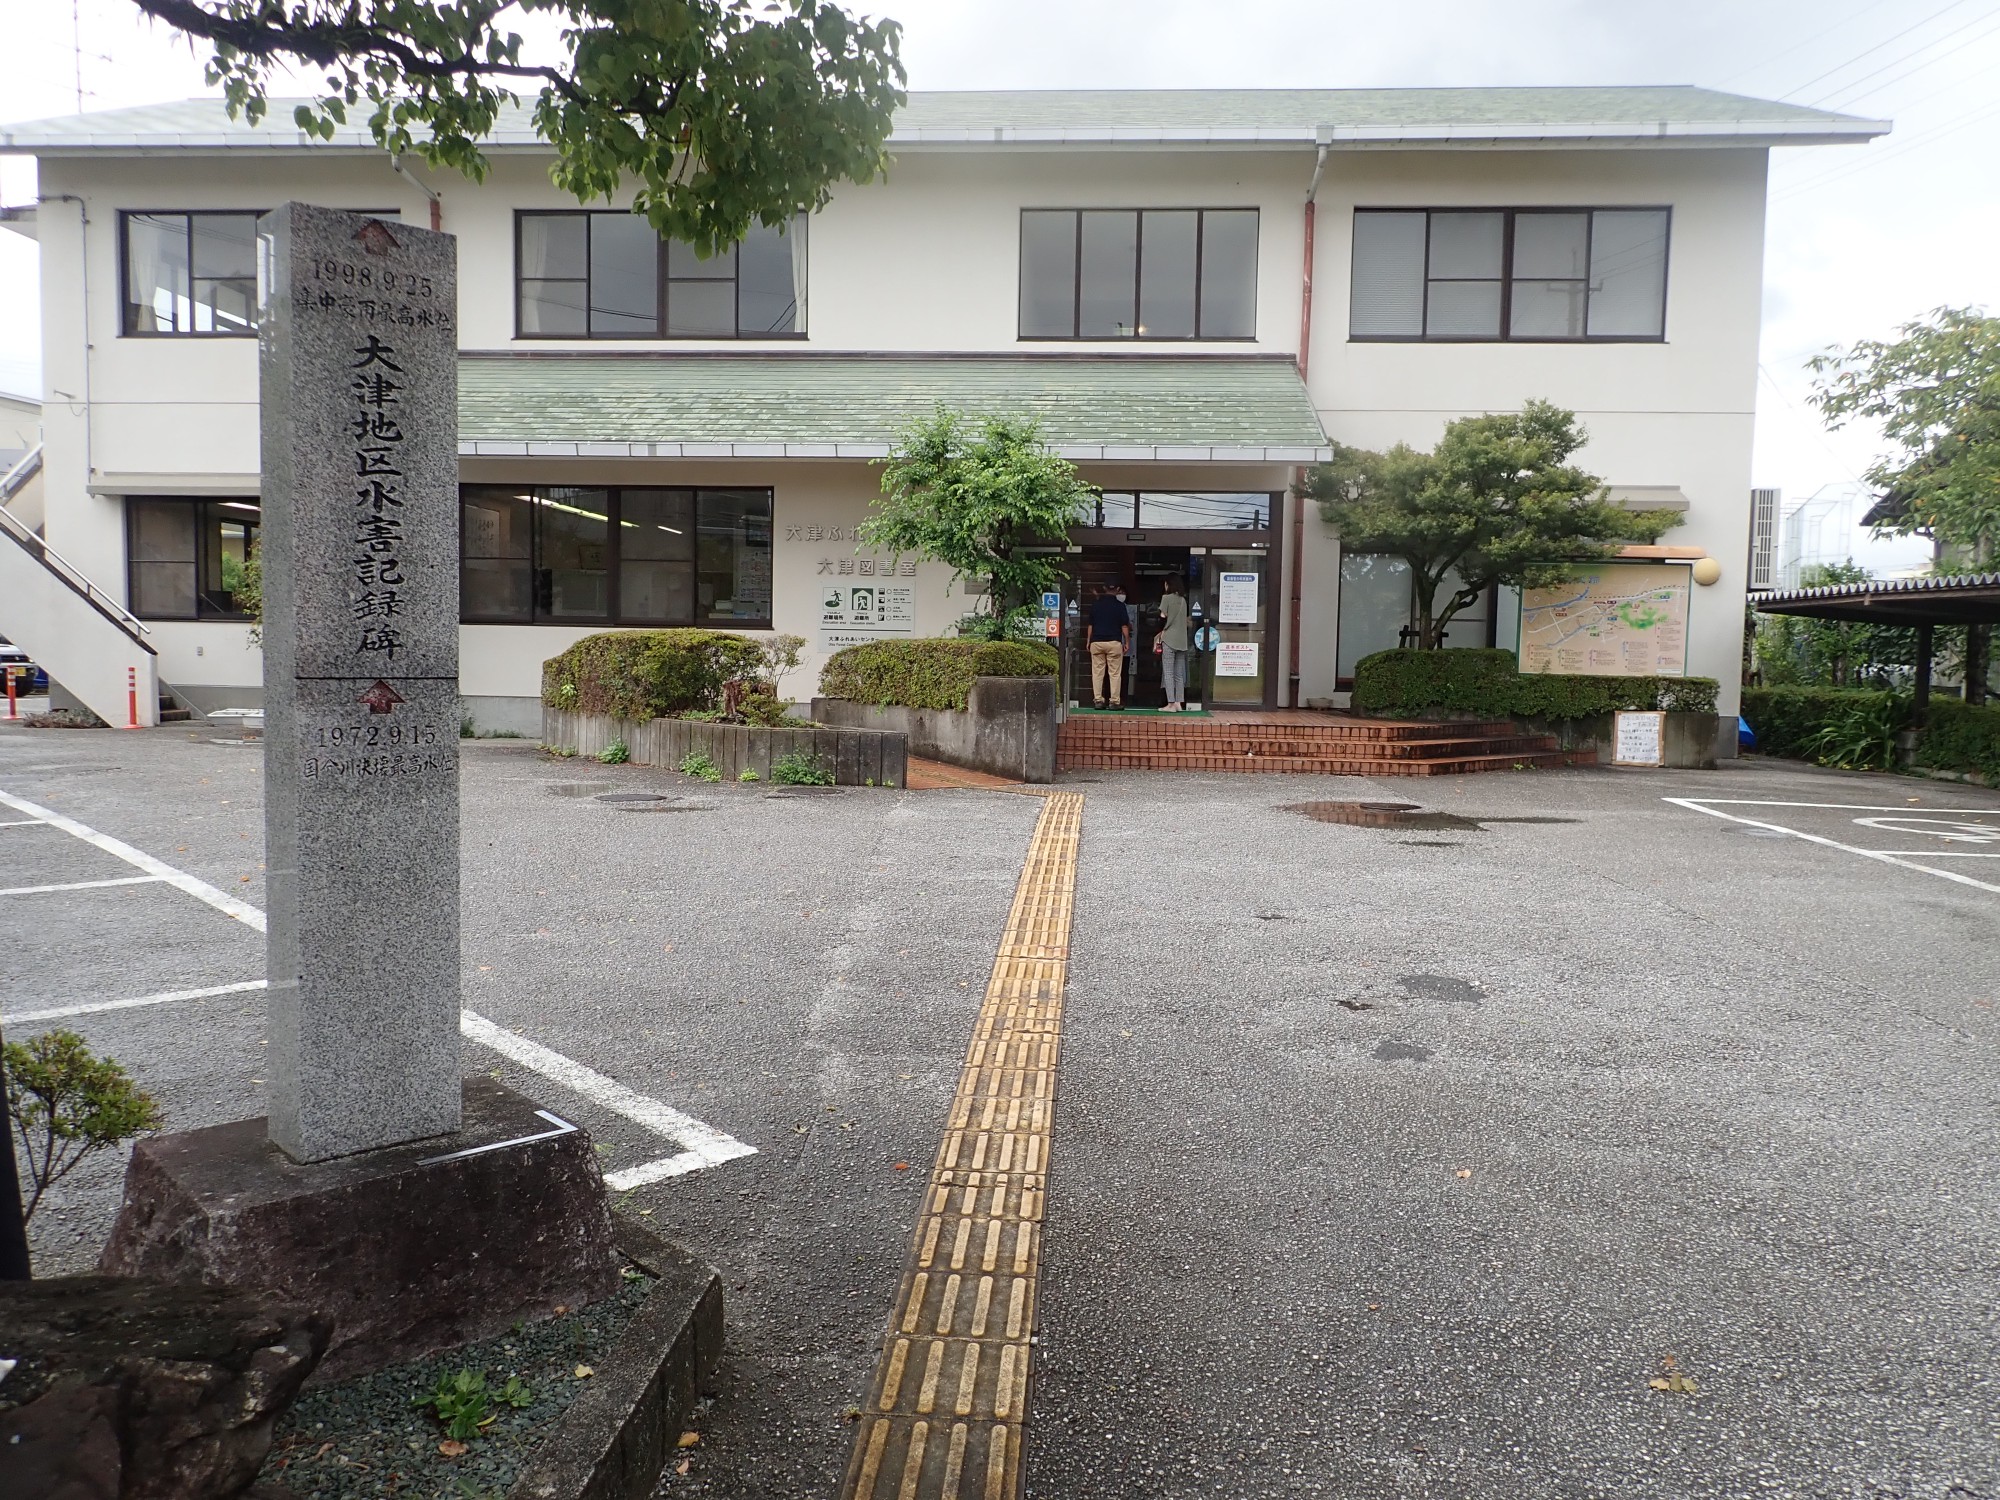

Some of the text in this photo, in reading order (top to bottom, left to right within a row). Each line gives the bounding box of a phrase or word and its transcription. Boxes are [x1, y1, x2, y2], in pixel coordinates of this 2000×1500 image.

[352, 335, 405, 661] 大津地区水害記録碑
[817, 558, 916, 576] 大津図書室
[318, 725, 436, 748] 1972.9.15
